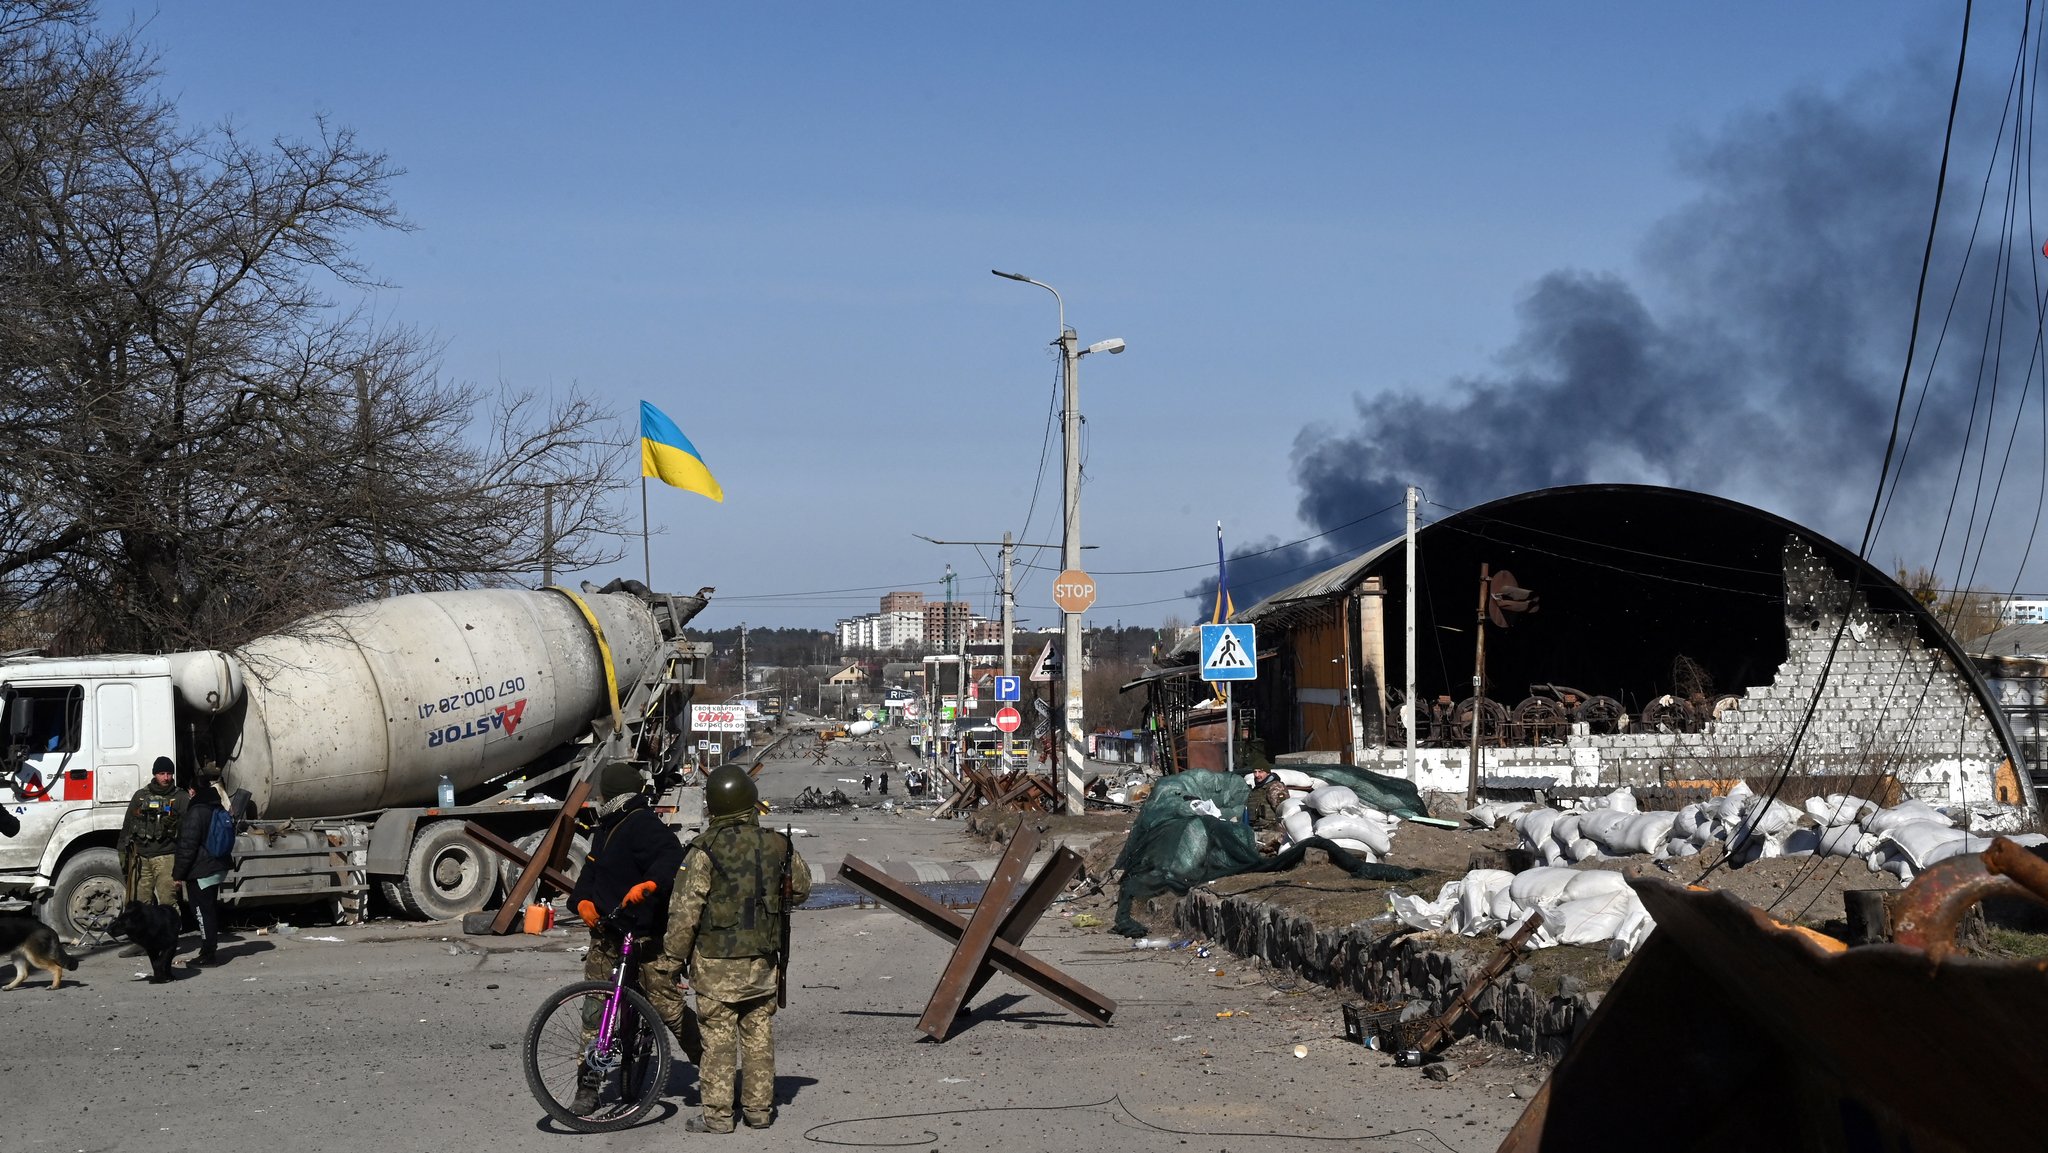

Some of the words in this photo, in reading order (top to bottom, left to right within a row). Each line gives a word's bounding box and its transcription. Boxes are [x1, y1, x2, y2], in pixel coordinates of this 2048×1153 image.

[1055, 584, 1094, 598] STOP
[499, 676, 526, 697] 067
[1001, 679, 1015, 699] P
[428, 712, 504, 748] ASTOR
